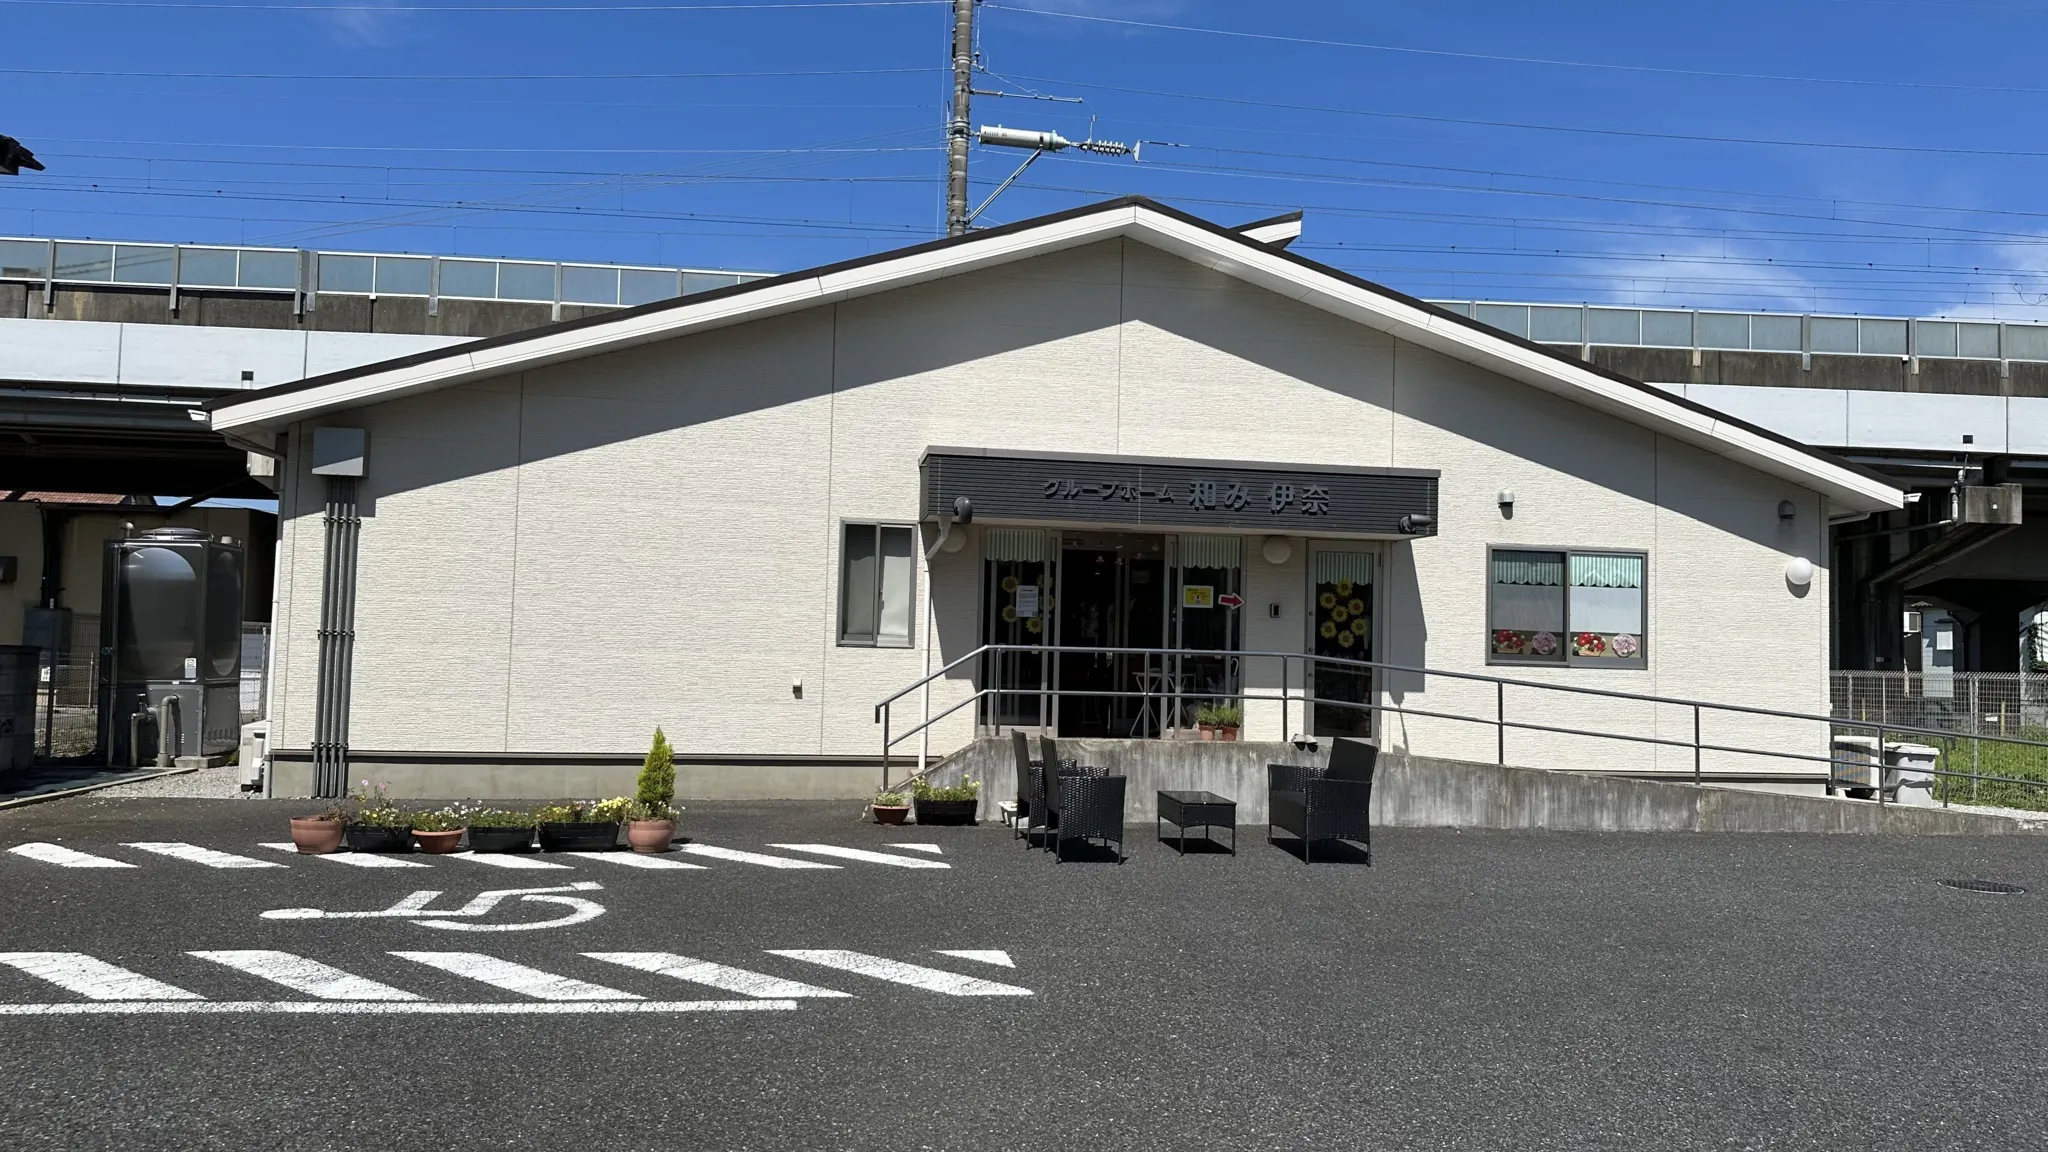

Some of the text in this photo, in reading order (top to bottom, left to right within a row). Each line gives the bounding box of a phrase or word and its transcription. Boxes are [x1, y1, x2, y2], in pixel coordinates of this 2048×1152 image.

[1041, 478, 1330, 515] グループホーム 和み 伊奈
